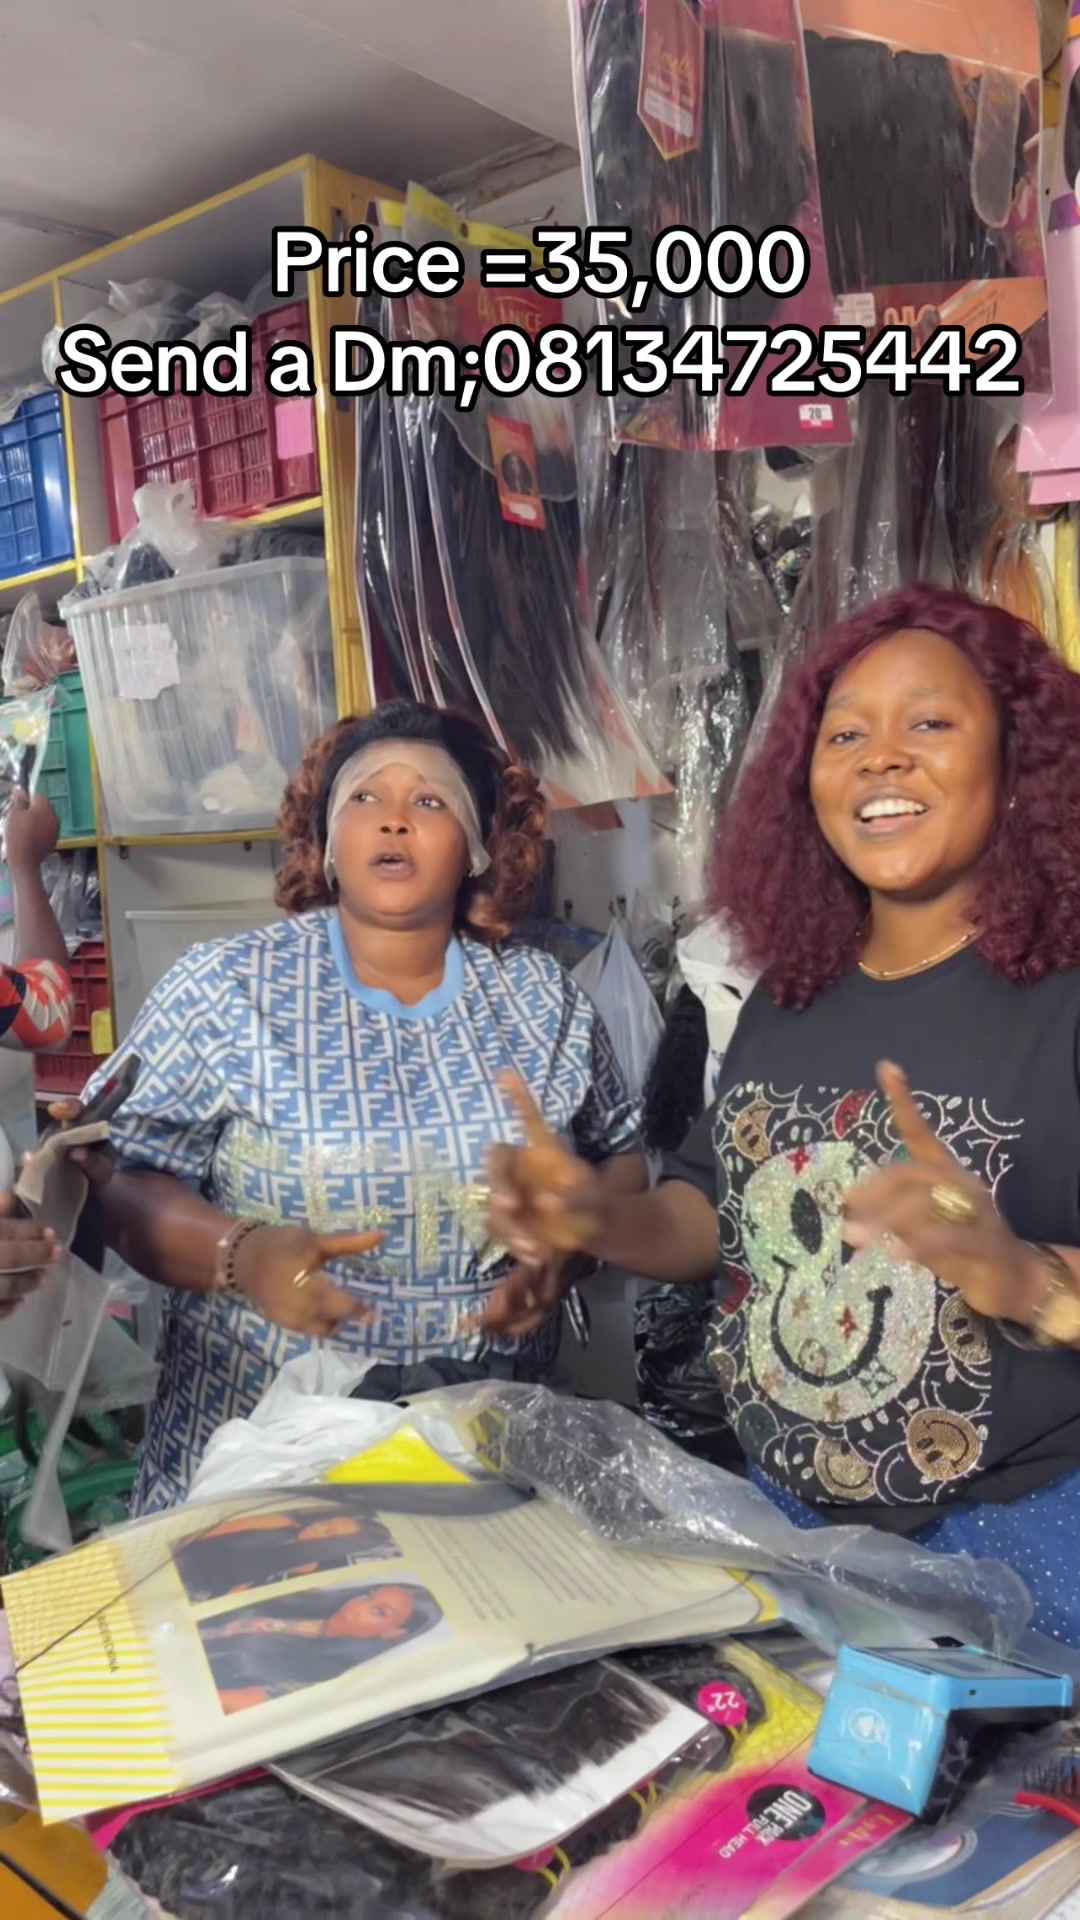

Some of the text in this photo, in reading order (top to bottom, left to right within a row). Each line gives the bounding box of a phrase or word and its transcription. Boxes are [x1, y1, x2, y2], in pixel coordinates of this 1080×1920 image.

[764, 1789, 812, 1829] ONE
[719, 1814, 769, 1859] FULL HEAD
